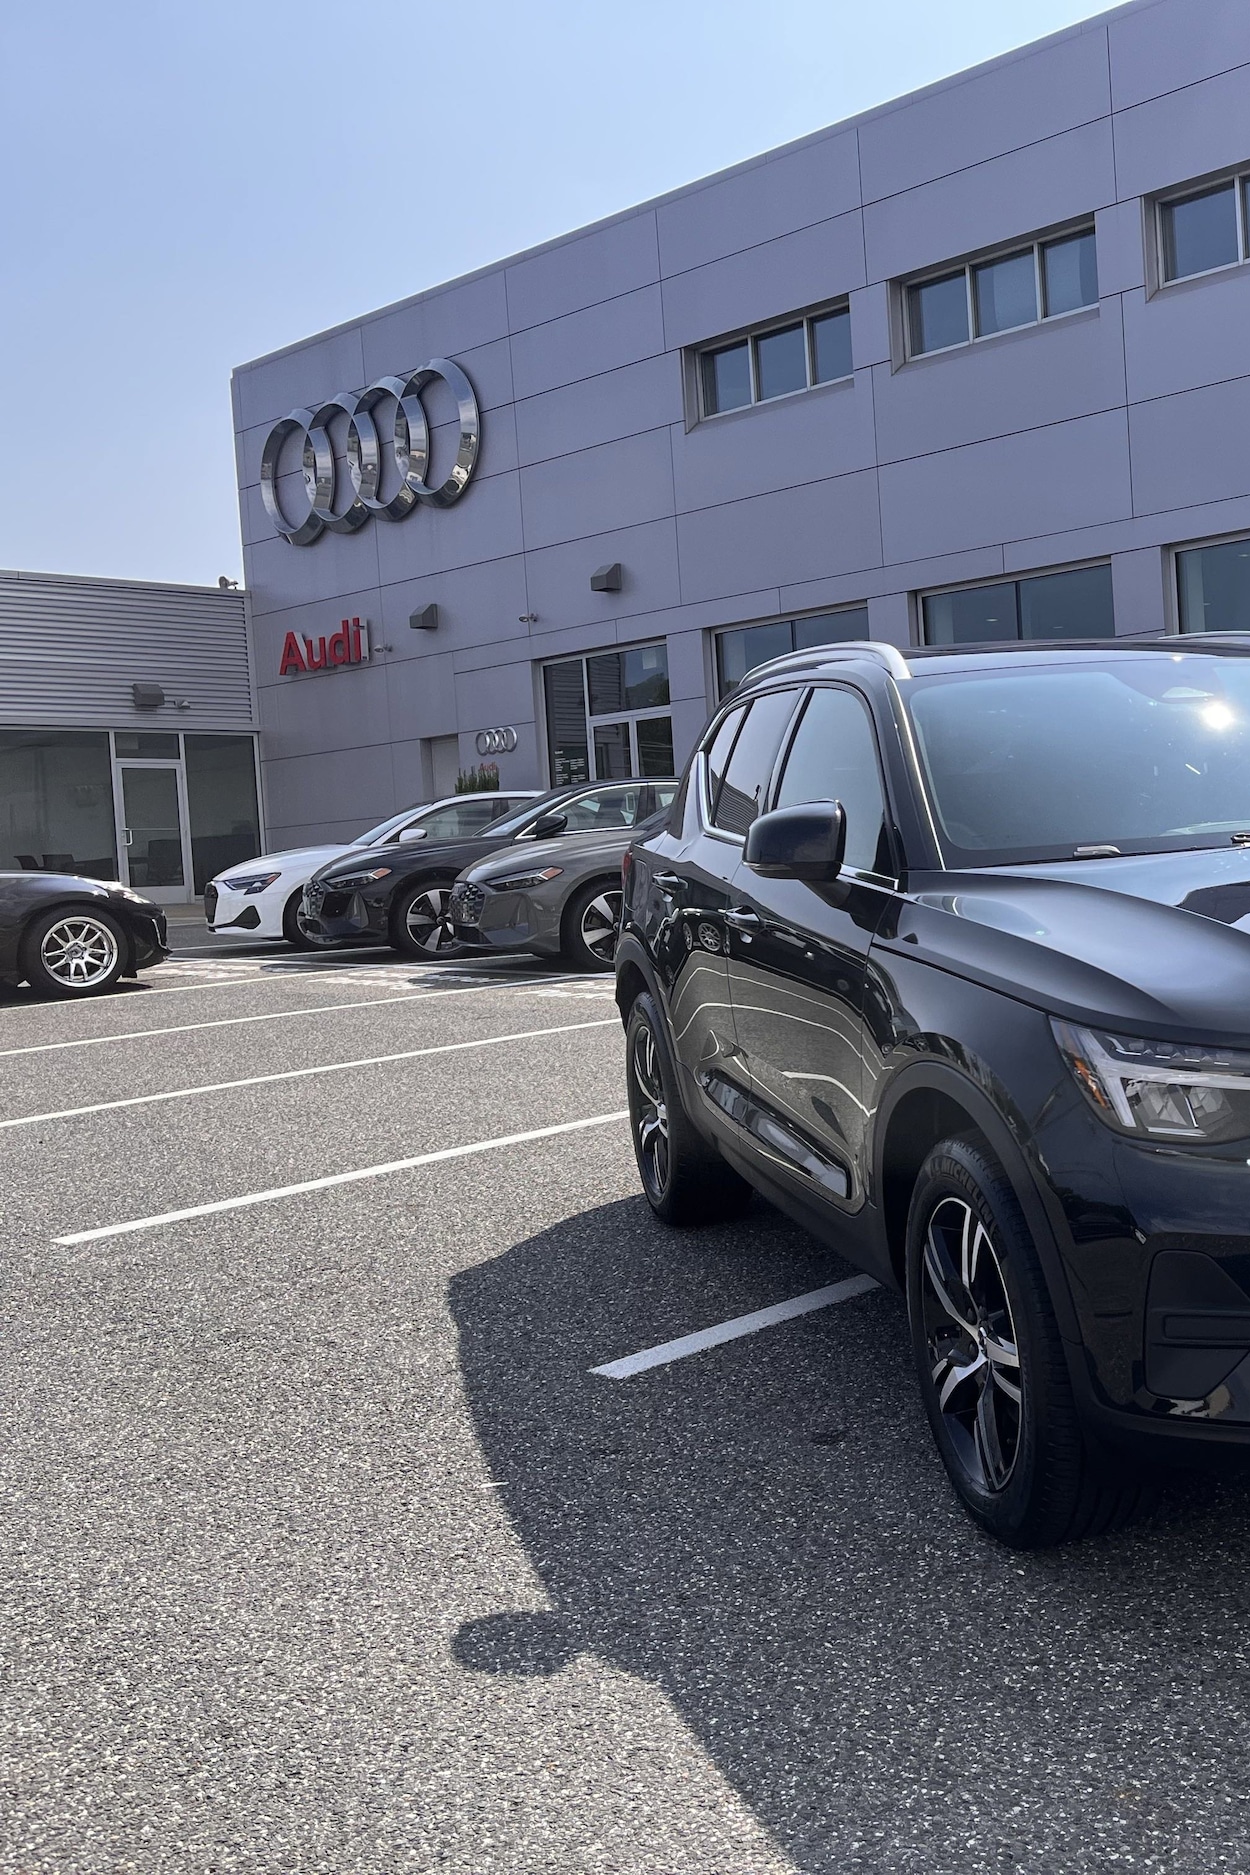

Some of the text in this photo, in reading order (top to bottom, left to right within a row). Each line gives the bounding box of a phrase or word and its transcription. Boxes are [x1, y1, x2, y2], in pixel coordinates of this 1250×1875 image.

[279, 617, 366, 676] Audi
[479, 761, 497, 771] Audi
[941, 1157, 995, 1224] MICHELIN
